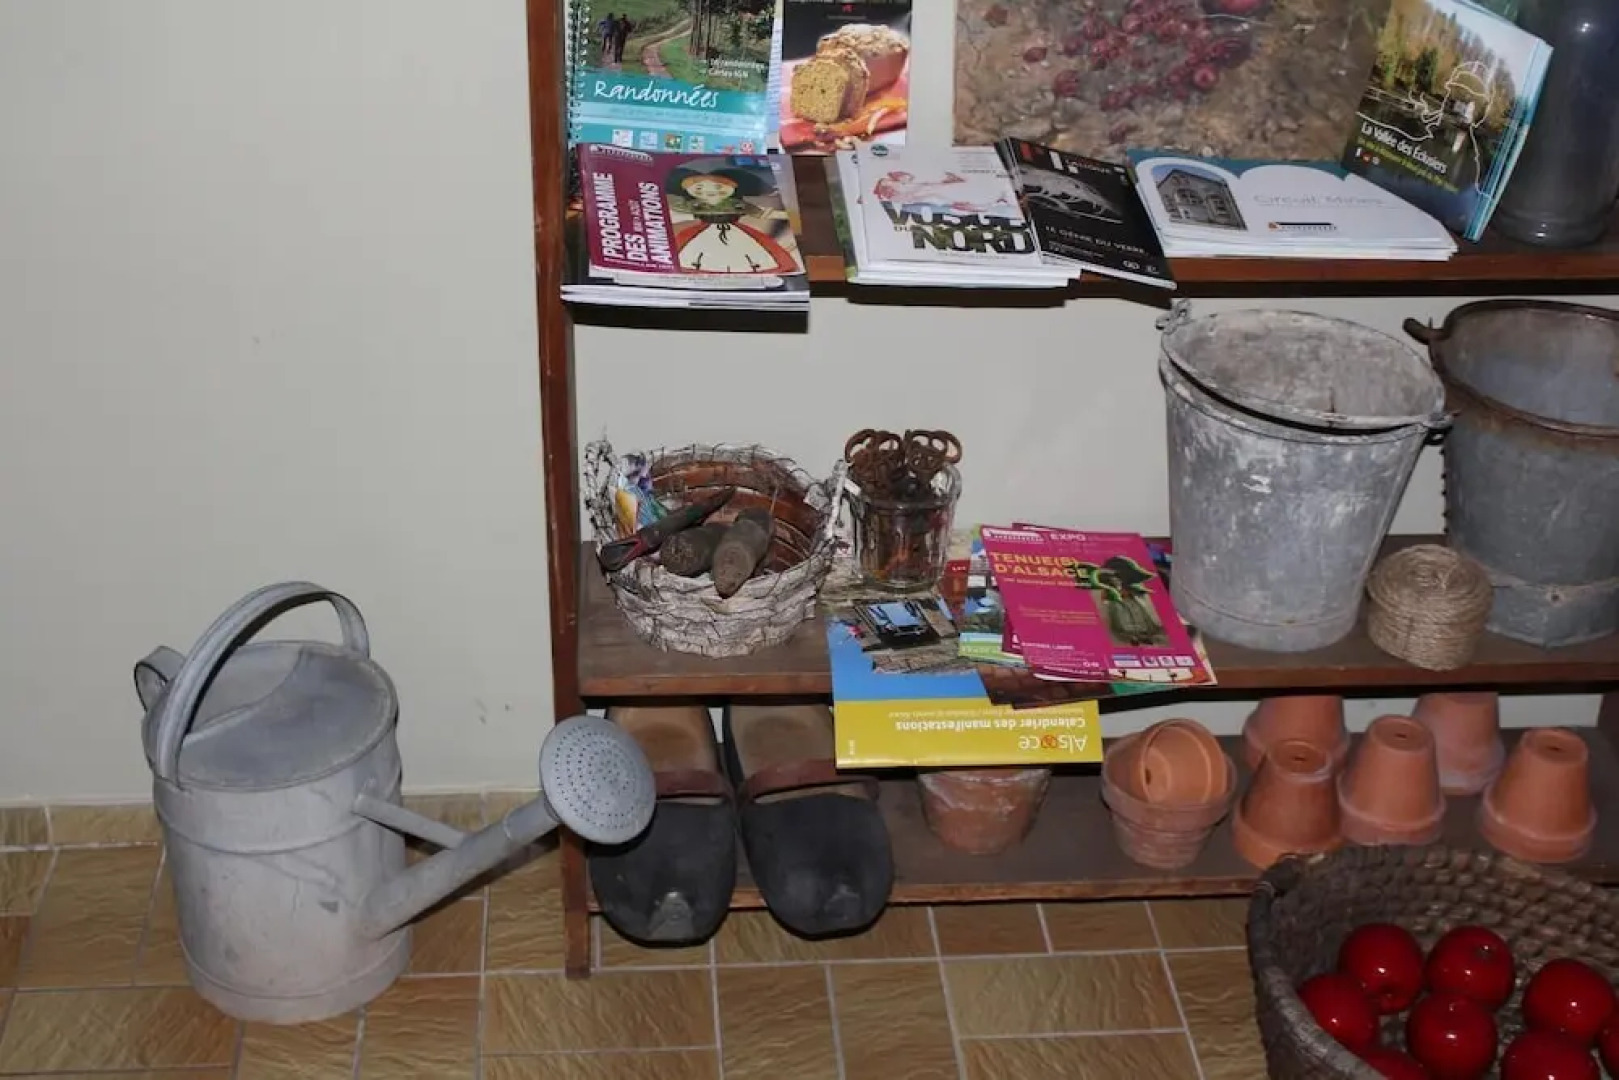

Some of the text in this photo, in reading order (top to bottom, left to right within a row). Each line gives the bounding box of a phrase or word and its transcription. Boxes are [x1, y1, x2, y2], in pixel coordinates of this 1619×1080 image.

[594, 80, 720, 108] Randonnées
[593, 173, 625, 258] PROGRAMME
[638, 182, 673, 265] ANIMATIONS
[625, 233, 649, 262] DES
[910, 225, 1036, 254] NORD
[1050, 533, 1087, 542] EXPO
[988, 551, 1078, 568] TENUE(S)
[993, 561, 1092, 579] D'ALSACE
[895, 717, 1086, 733] Calendrier des manifestations
